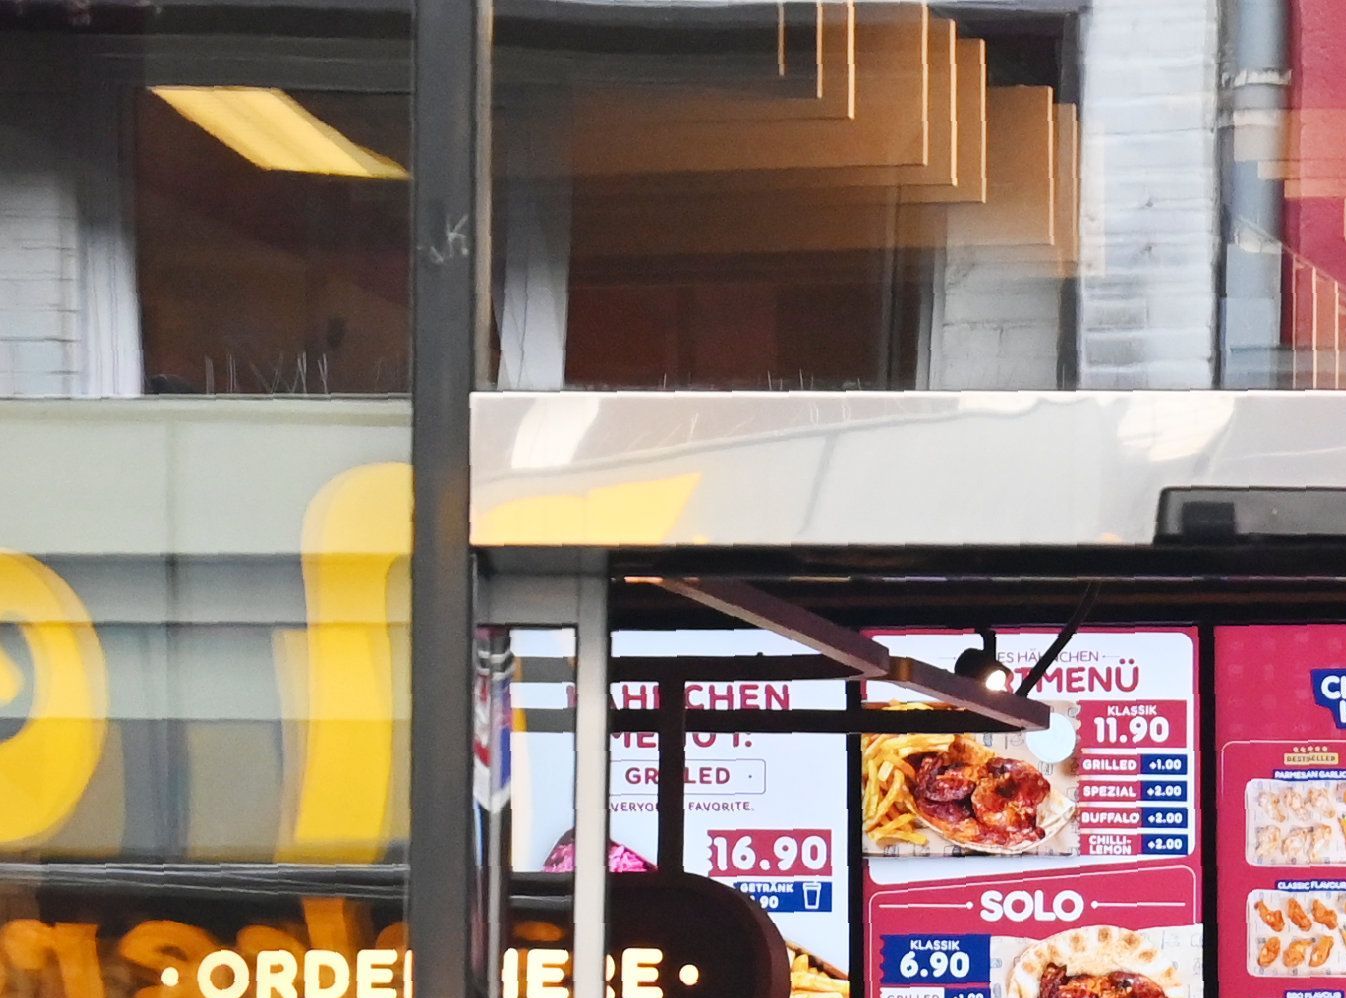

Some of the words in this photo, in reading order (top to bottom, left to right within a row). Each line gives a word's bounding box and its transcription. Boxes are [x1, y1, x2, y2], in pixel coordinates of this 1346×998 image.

[1107, 705, 1157, 716] KLASSIK
[1094, 716, 1170, 743] 11.90
[1082, 759, 1137, 771] GRILLED
[1149, 758, 1182, 771] +1.00
[625, 767, 731, 785] GRLED
[1083, 786, 1136, 797] SPEZIAL
[1147, 785, 1182, 797] +2.00
[1081, 812, 1140, 823] BUFFALO
[1148, 812, 1183, 824] +2.00
[1089, 835, 1132, 845] CHILLI-
[1148, 838, 1183, 850] +2.00
[713, 835, 827, 871] 16.90
[1089, 845, 1132, 855] LEMON
[980, 890, 1084, 922] SOLO
[910, 939, 960, 951] KLASSIK
[900, 951, 970, 978] 6.90
